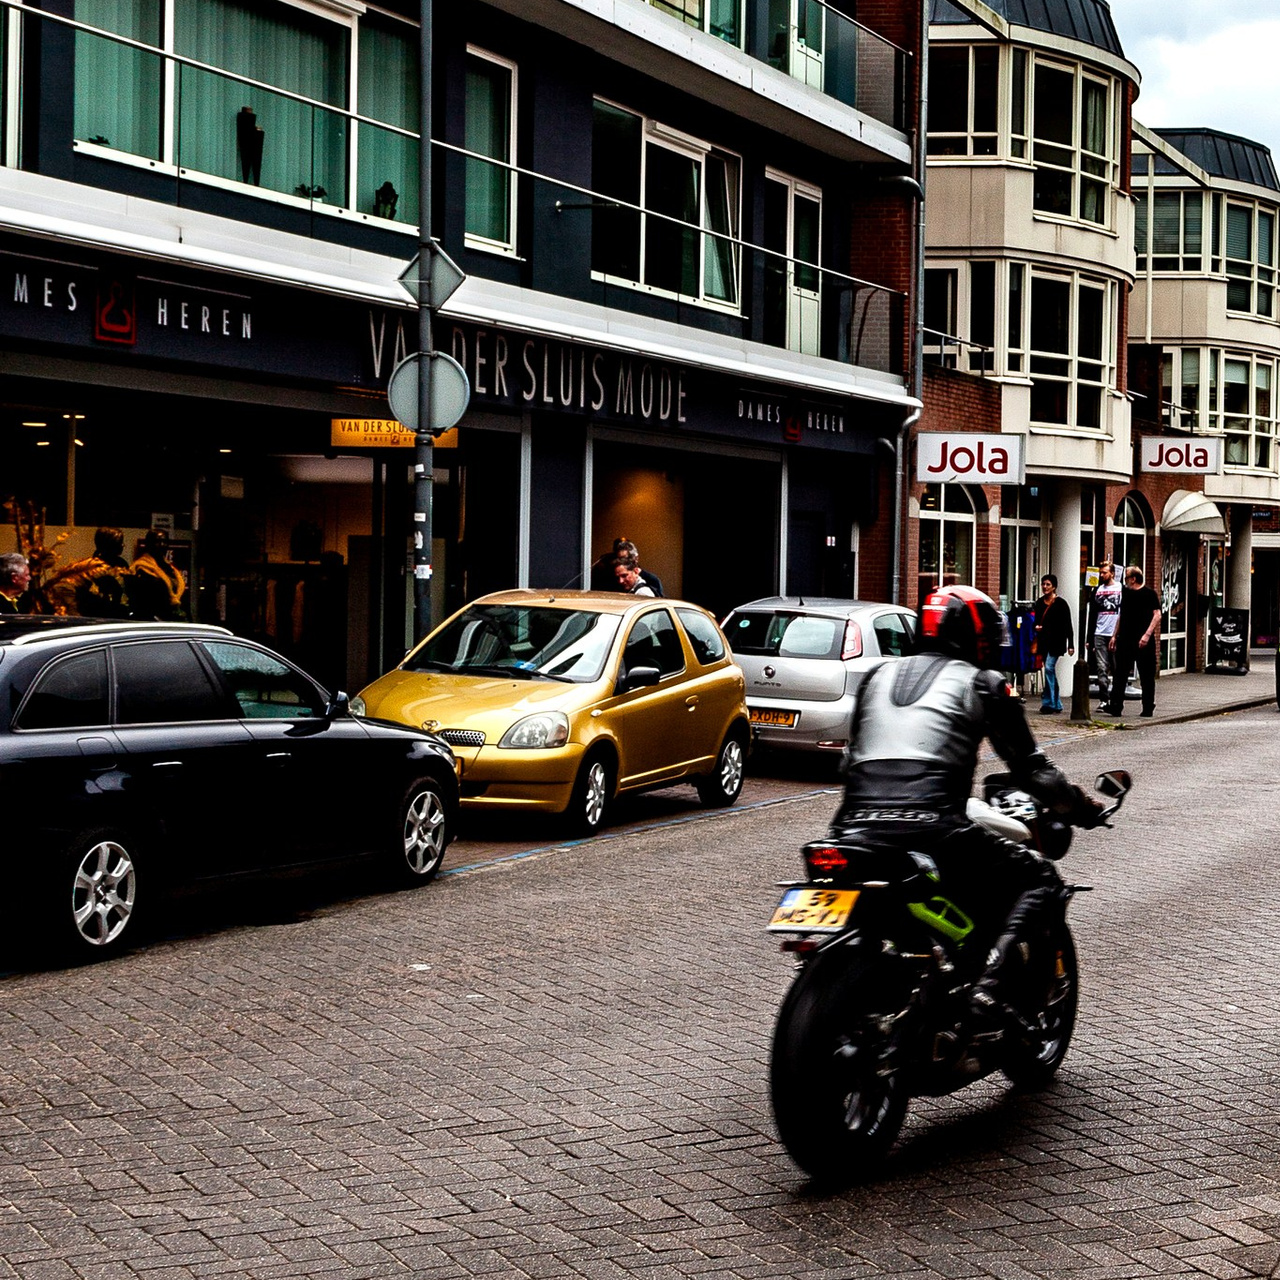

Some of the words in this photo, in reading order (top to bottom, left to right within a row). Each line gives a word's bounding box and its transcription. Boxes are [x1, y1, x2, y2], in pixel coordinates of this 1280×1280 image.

[13, 273, 77, 311] MES
[157, 298, 252, 339] HEREN
[369, 310, 433, 380] VA
[452, 327, 508, 397] DER
[522, 339, 604, 411] SLUIS
[616, 359, 686, 423] MODE
[738, 399, 781, 423] DAMES
[340, 421, 360, 432] VAN
[363, 421, 384, 433] DER
[385, 422, 416, 434] SLU
[927, 441, 1009, 475] Jola
[1148, 443, 1209, 468] Jola
[809, 891, 839, 907] 59
